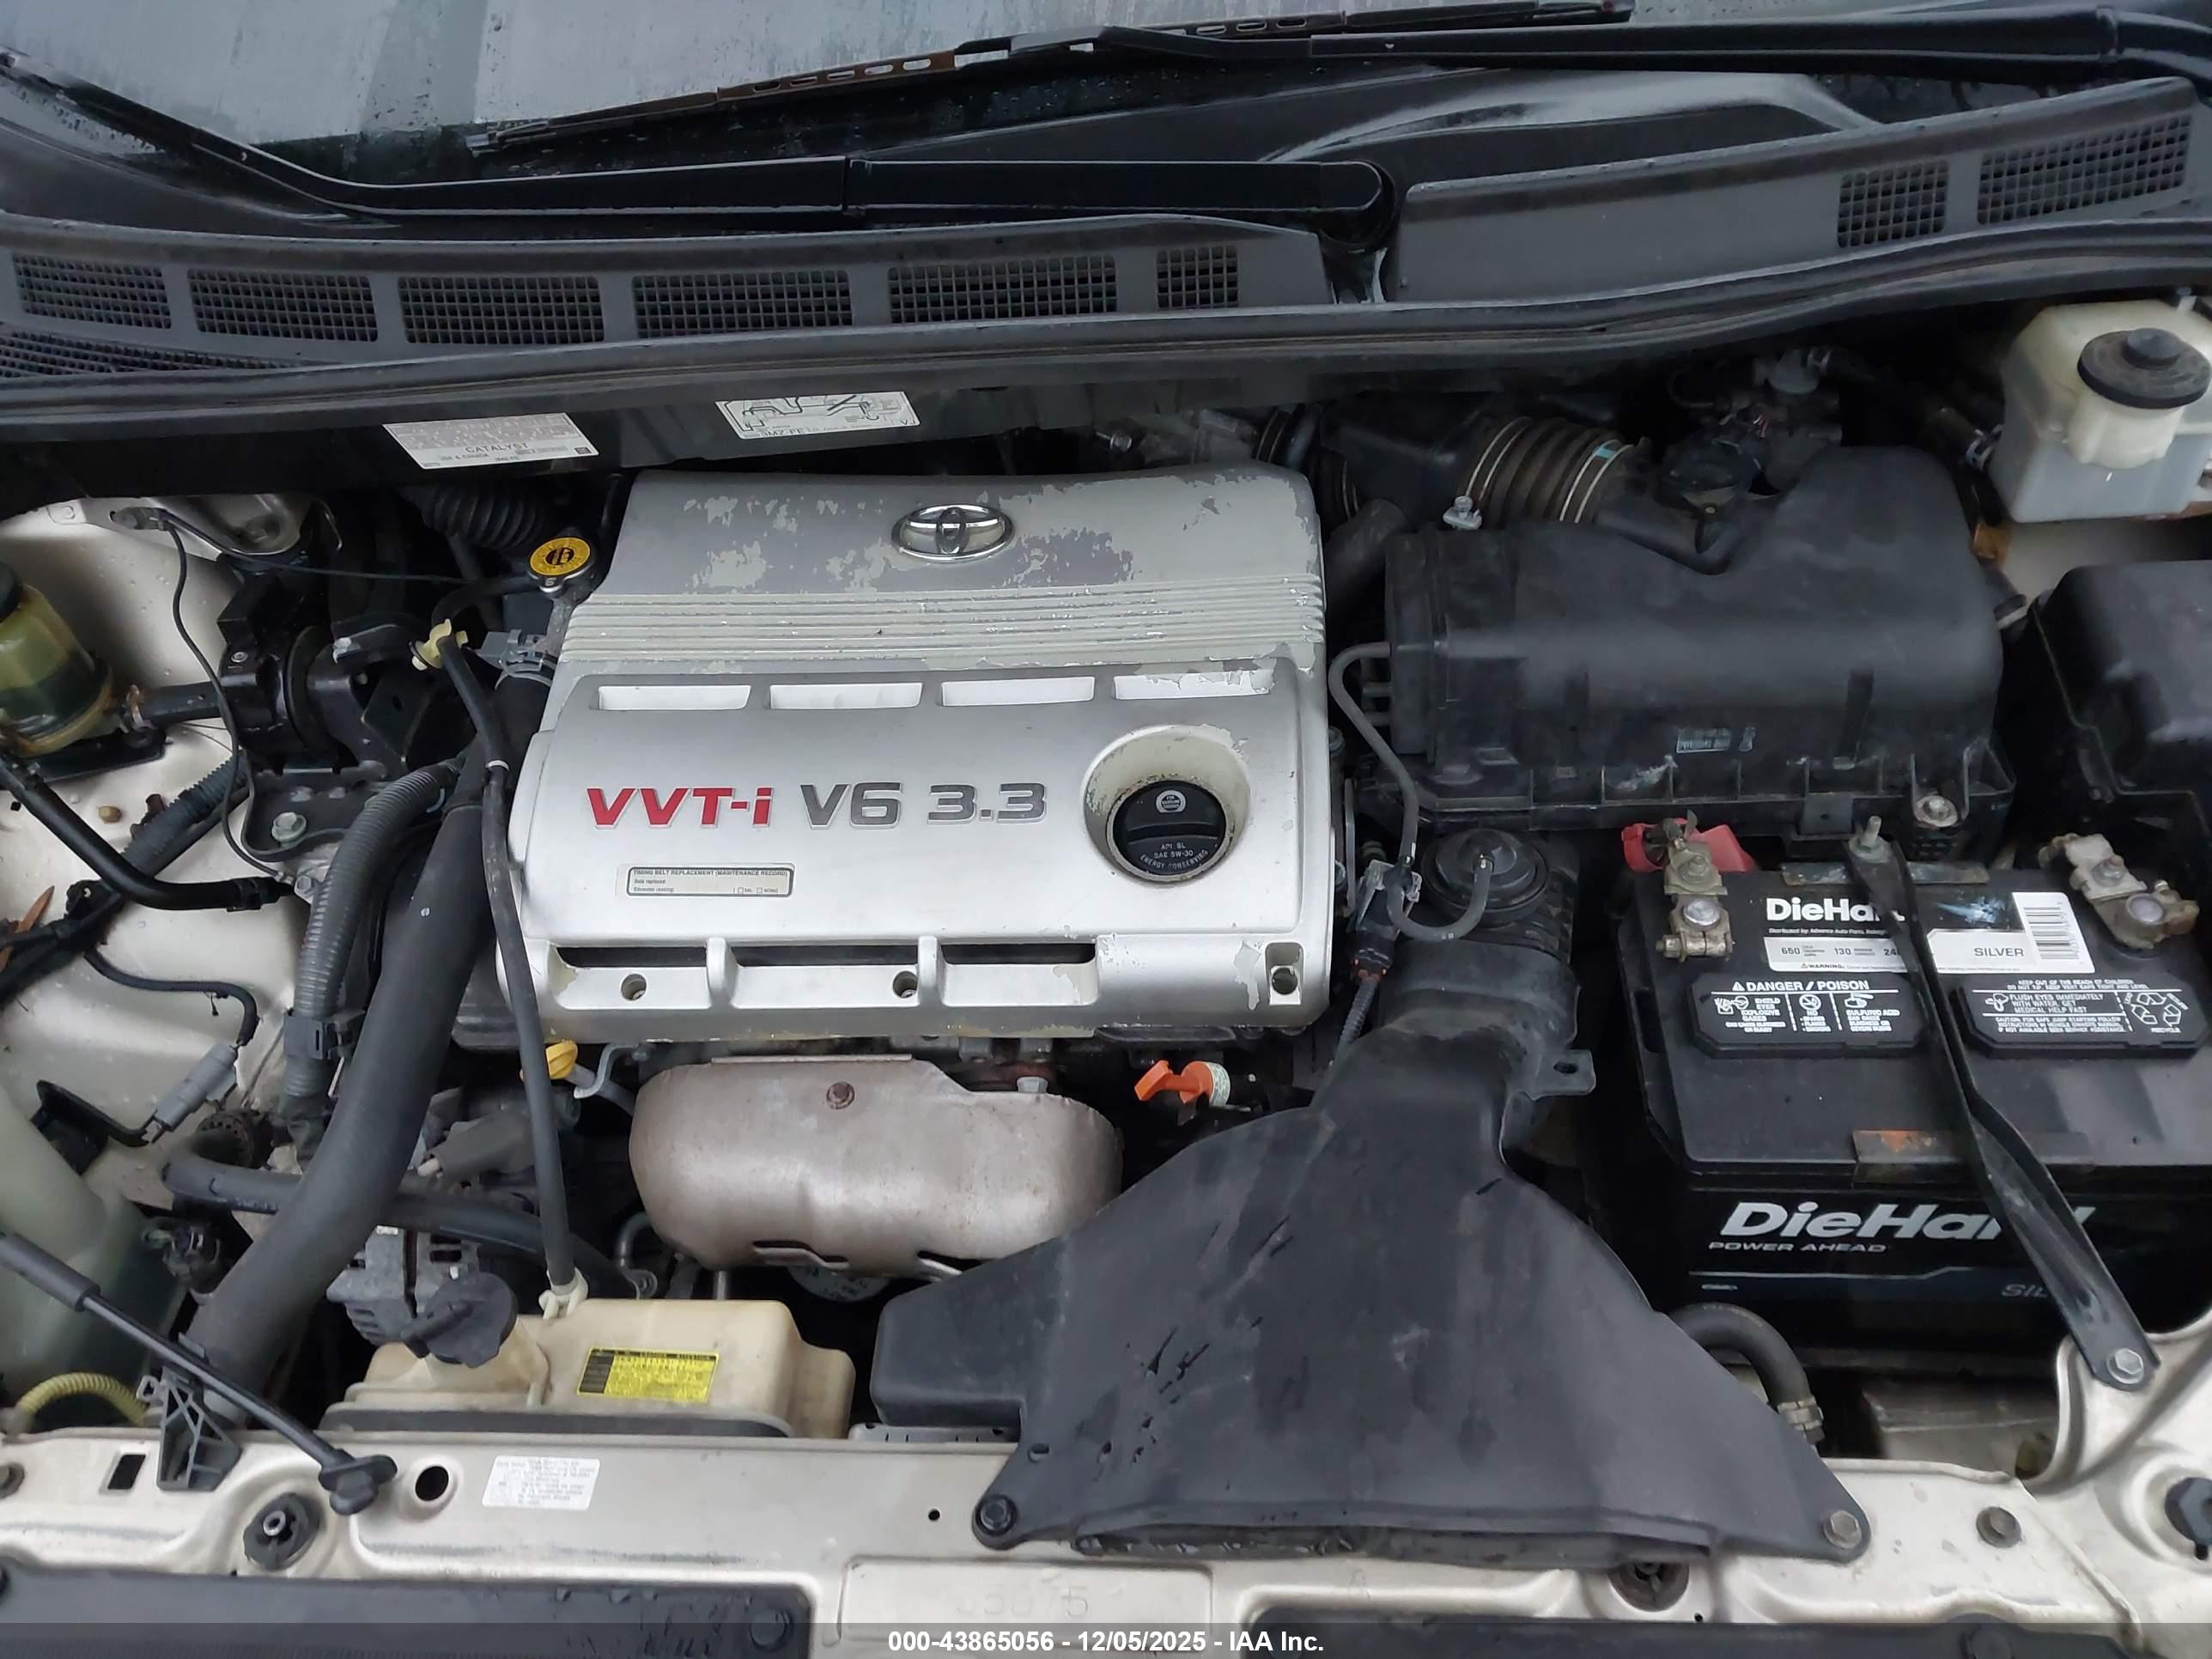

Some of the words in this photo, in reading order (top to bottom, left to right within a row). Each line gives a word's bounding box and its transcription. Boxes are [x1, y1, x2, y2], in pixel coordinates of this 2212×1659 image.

[465, 442, 530, 453] CATALYST
[586, 787, 773, 829] VVT-i
[800, 782, 902, 830] V6
[927, 782, 1047, 824] 3.3
[1139, 854, 1165, 869] ENERGY
[1168, 849, 1208, 870] CONSERVING
[1766, 896, 1905, 921] DieHa
[1834, 947, 1852, 956] 130
[1974, 947, 2025, 957] SILVER
[1746, 981, 1803, 991] DANGER
[1805, 981, 1814, 991] /
[1817, 981, 1869, 990] POISON
[1709, 1242, 1795, 1251] POWER
[1800, 1243, 1887, 1252] AHEAD
[2001, 1283, 2048, 1297] SIL
